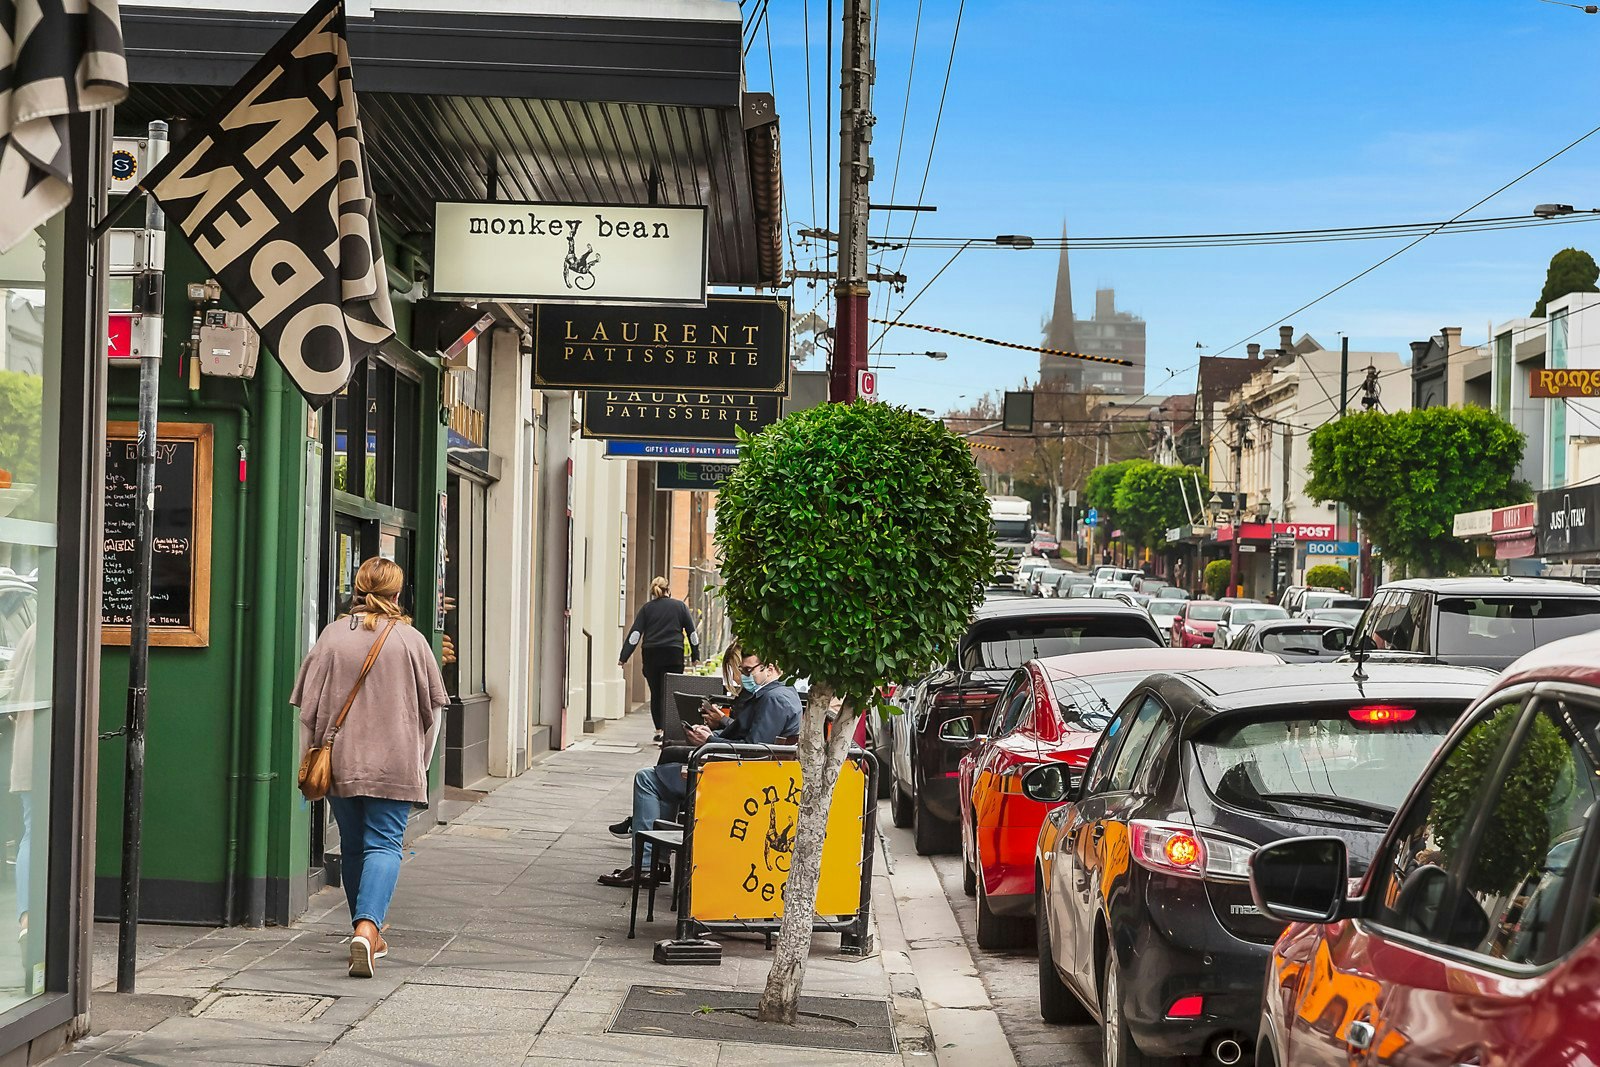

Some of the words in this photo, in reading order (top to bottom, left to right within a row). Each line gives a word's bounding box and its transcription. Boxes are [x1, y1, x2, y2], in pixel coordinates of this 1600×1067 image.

[469, 212, 583, 237] monkey
[595, 214, 670, 239] bean
[565, 320, 759, 345] LAURENT
[564, 347, 759, 366] PATISSERIE
[864, 375, 871, 392] C
[606, 405, 758, 421] PATISSERIE
[1550, 510, 1565, 530] JUST
[1570, 507, 1586, 527] ITALY
[1299, 526, 1331, 537] POST
[104, 538, 136, 553] MEN
[1309, 543, 1334, 553] BOQ
[730, 777, 801, 842] monk
[1230, 904, 1261, 915] maz
